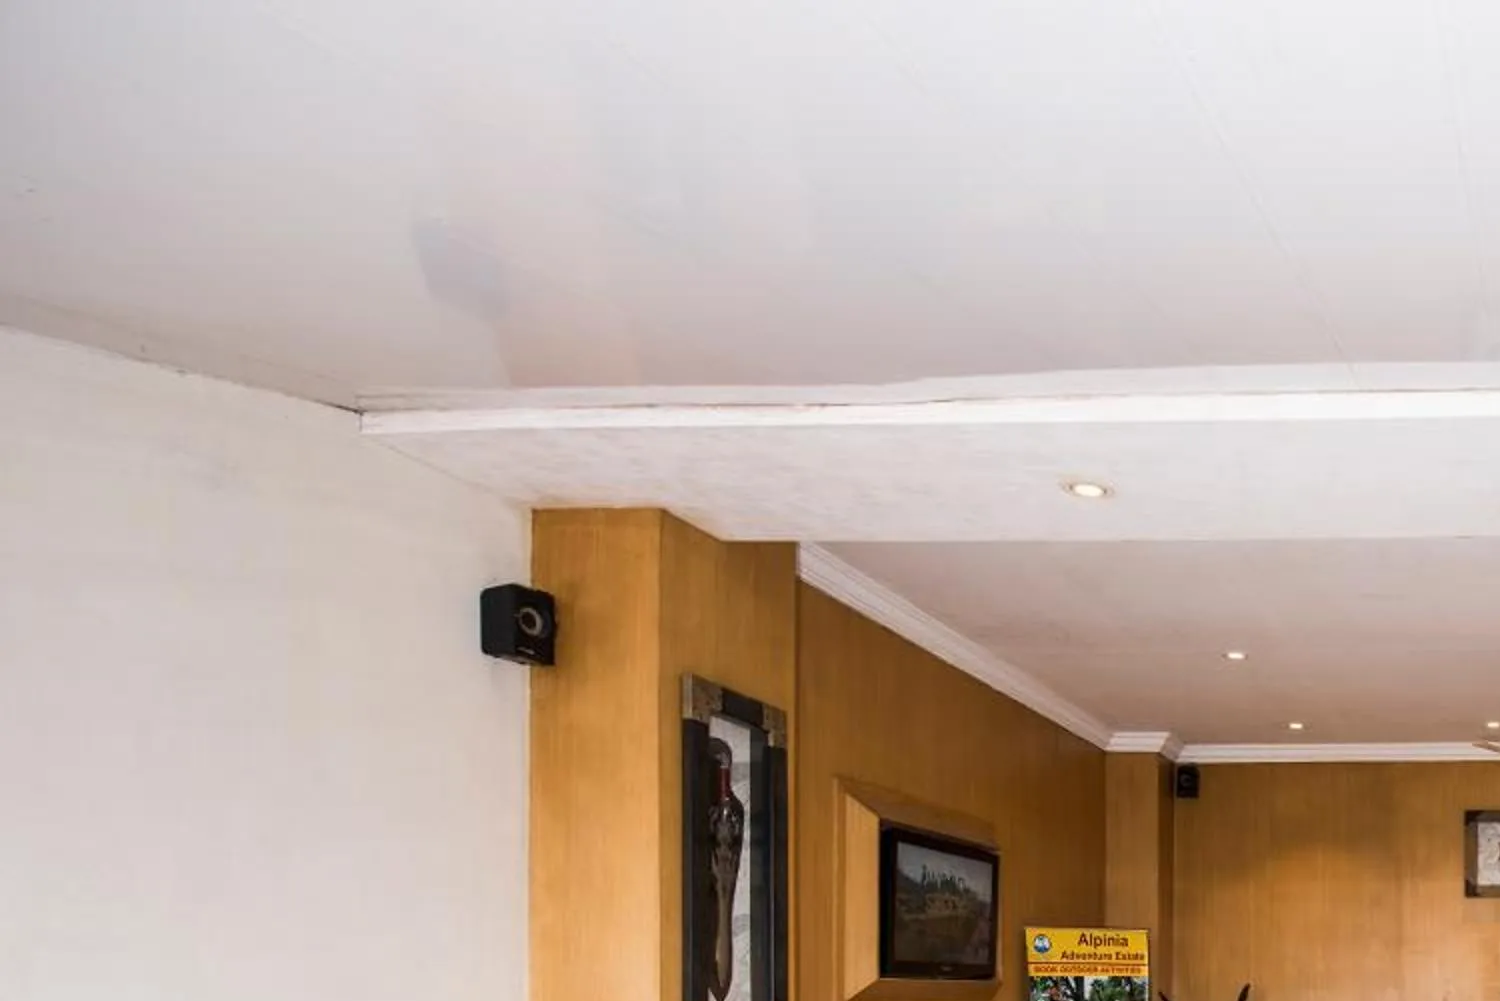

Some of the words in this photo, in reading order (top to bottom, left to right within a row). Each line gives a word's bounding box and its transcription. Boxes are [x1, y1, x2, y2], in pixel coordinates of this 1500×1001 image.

[1077, 932, 1129, 949] Alpinia
[1060, 950, 1113, 961] Adventure
[1115, 951, 1145, 961] Estate
